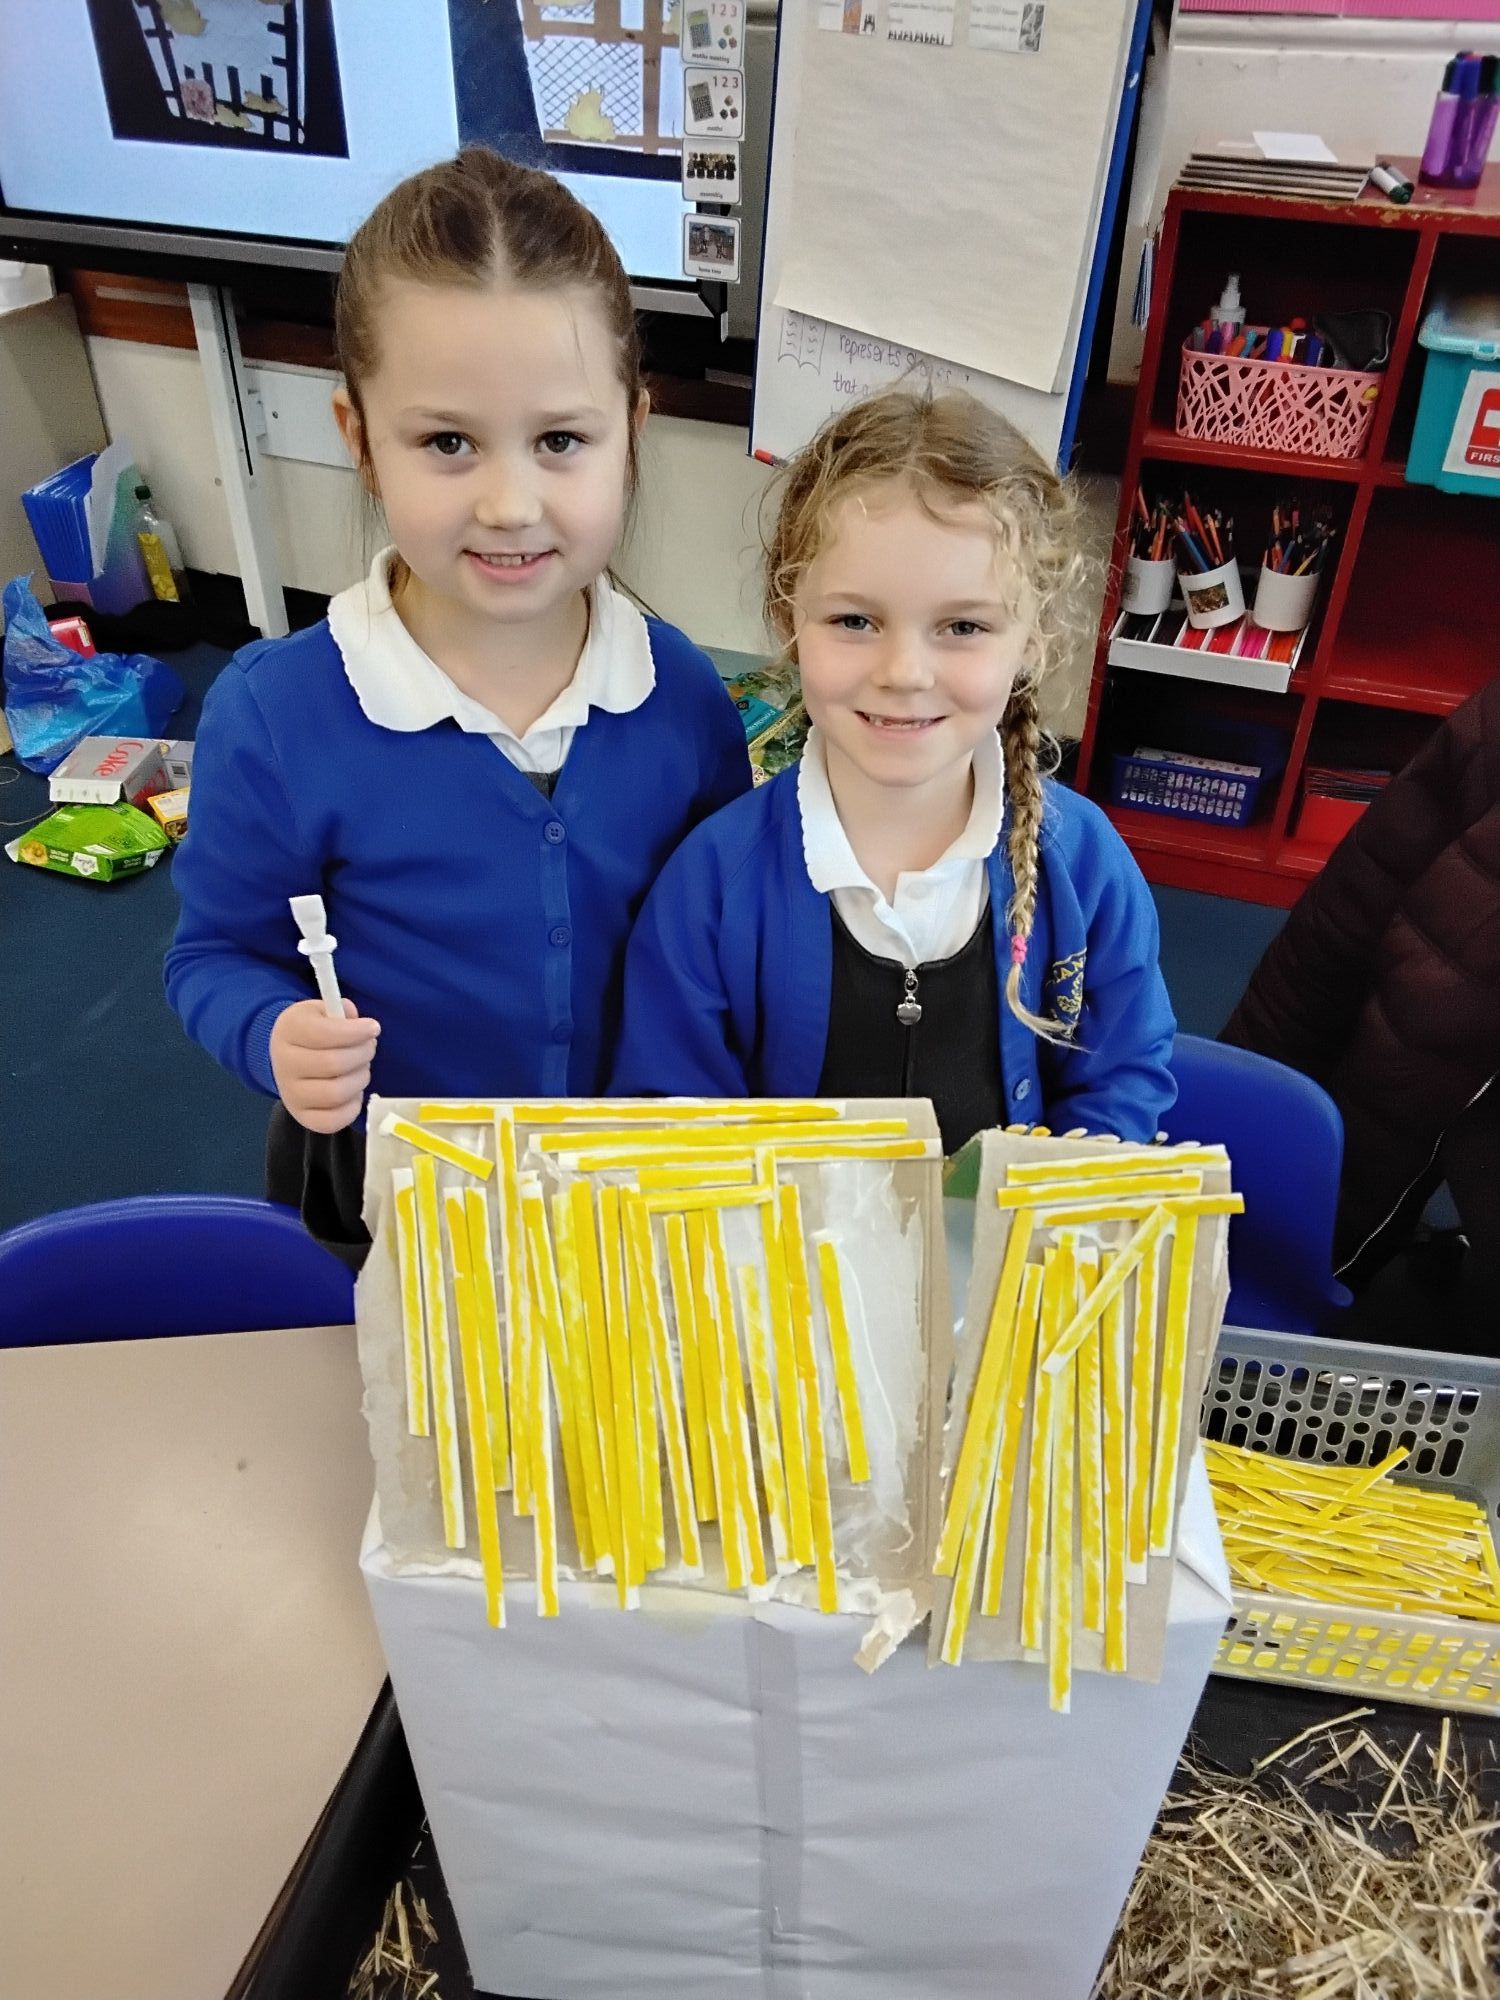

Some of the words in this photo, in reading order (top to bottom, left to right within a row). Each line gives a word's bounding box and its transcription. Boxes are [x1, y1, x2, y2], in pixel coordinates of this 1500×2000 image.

[711, 3, 716, 15] 1
[720, 3, 727, 16] 2
[730, 5, 737, 17] 3
[713, 76, 718, 87] 1
[721, 76, 728, 88] 2
[732, 77, 739, 89] 3
[833, 371, 857, 394] that
[93, 742, 144, 777] Coke
